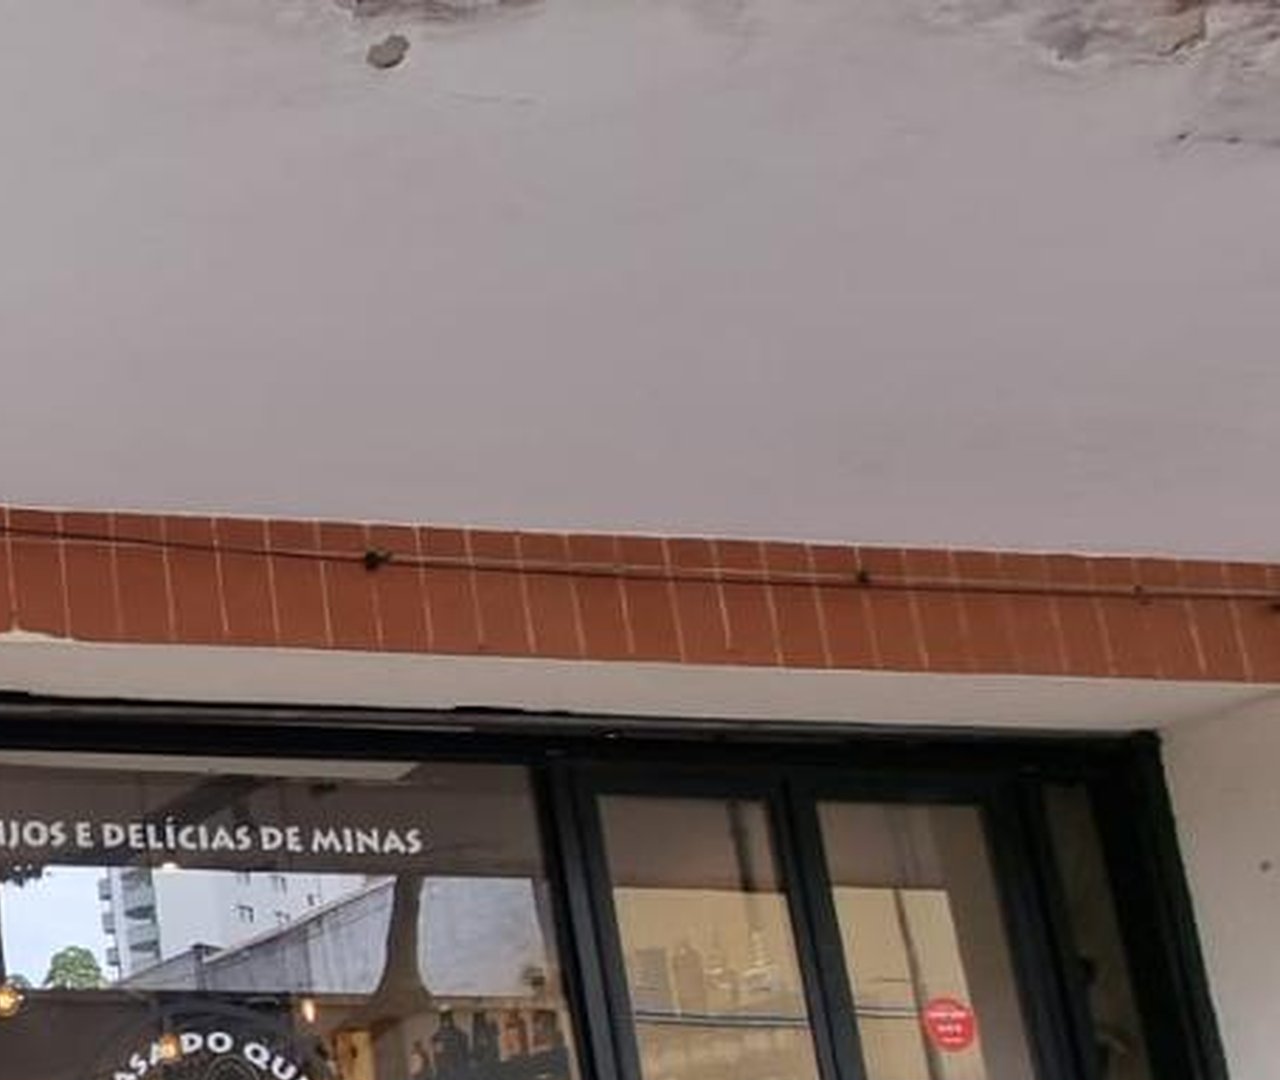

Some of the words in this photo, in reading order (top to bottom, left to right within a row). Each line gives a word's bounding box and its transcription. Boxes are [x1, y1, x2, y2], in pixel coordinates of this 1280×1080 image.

[76, 821, 94, 848] E
[102, 816, 251, 851] DELÍCIAS
[260, 827, 303, 852] DE
[312, 827, 423, 855] MINAS
[180, 1031, 233, 1054] DO
